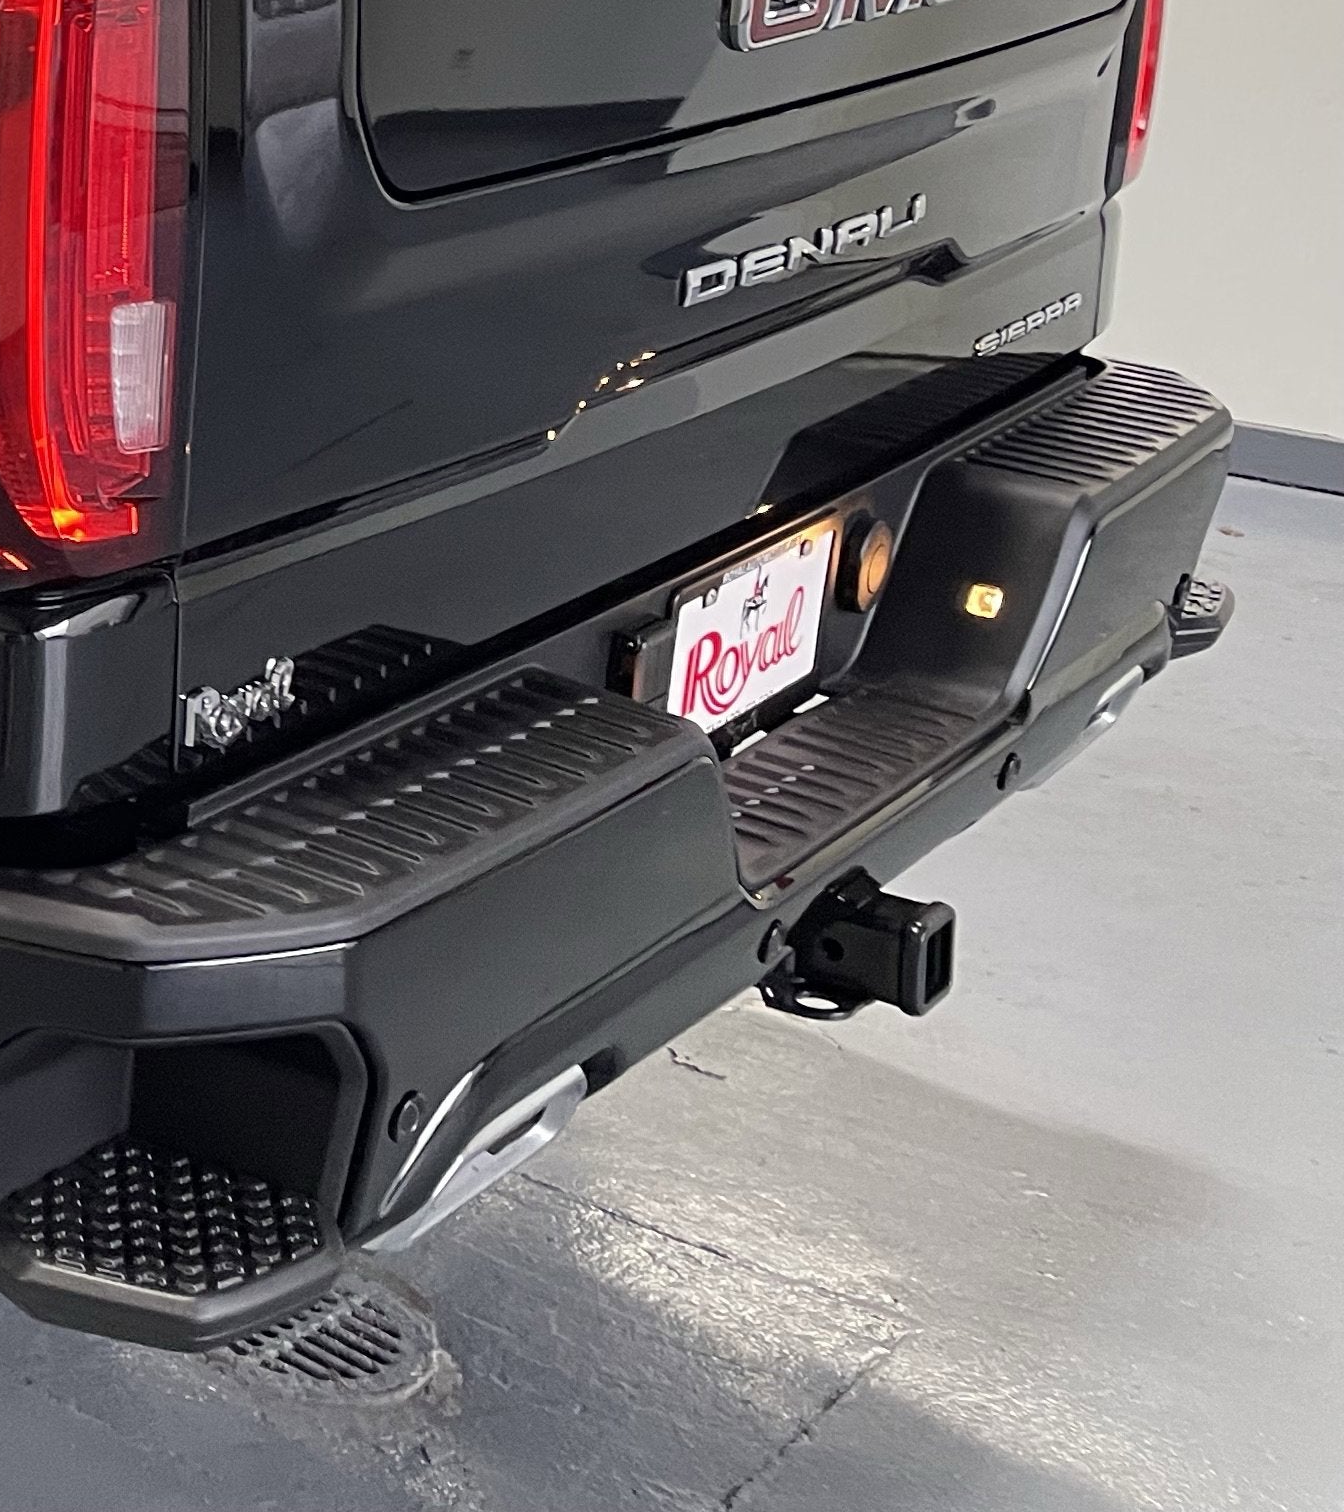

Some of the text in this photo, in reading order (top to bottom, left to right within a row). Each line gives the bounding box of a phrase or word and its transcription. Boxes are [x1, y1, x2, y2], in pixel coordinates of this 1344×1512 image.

[679, 192, 928, 308] DENALI
[972, 291, 1084, 358] SIERRA
[680, 585, 805, 716] Royal
